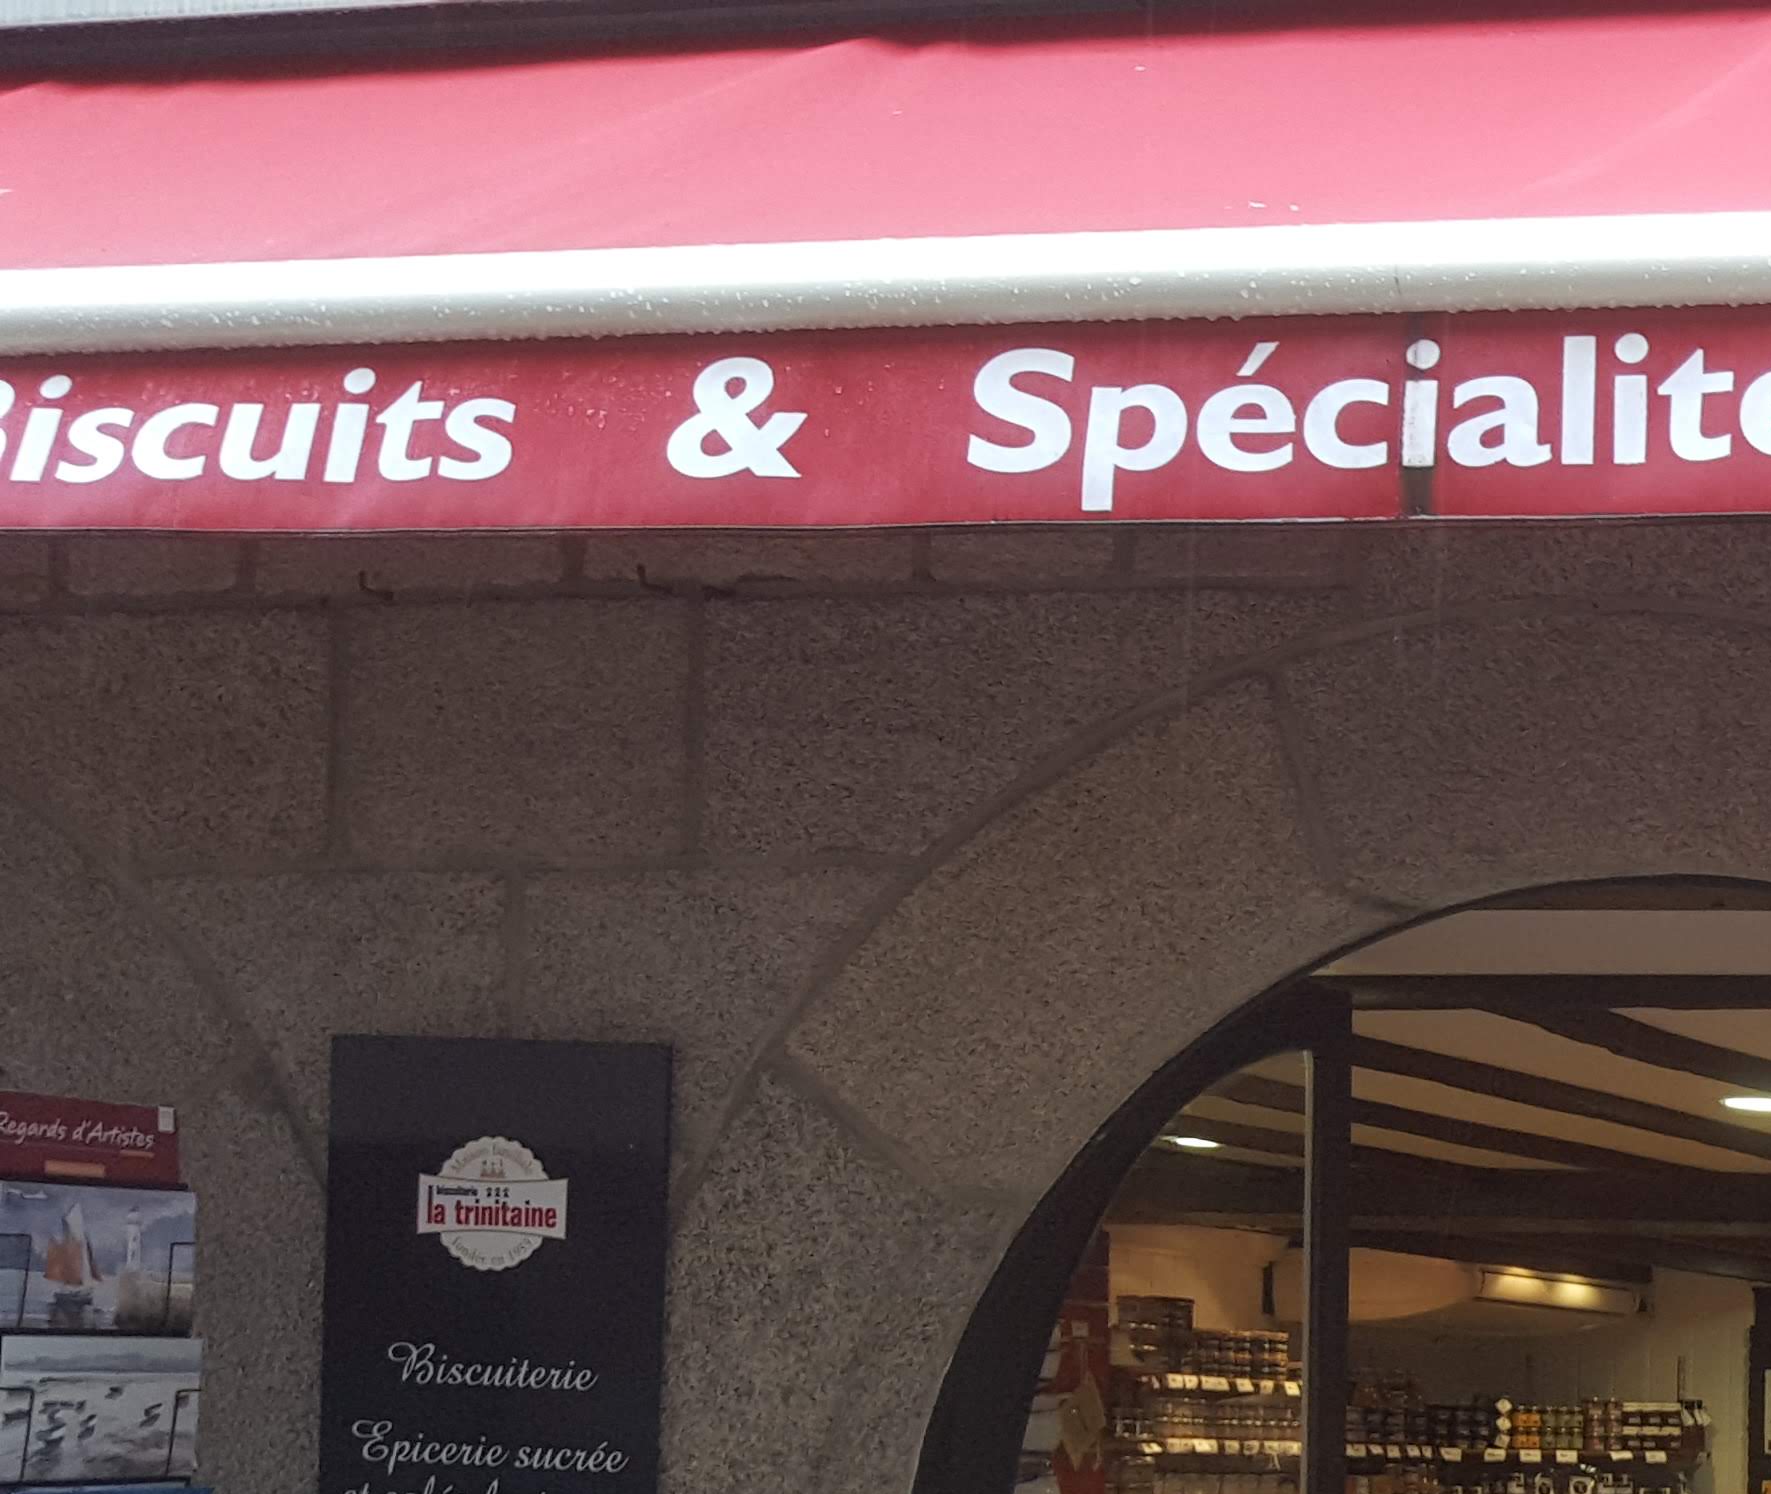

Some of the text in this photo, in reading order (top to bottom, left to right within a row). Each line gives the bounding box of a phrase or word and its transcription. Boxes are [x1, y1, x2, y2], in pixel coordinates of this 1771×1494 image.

[0, 366, 516, 488] iscuits
[666, 356, 803, 479] &
[72, 1119, 155, 1149] d'Artistes
[427, 1185, 557, 1228] la trinitaine
[388, 1341, 599, 1392] Biscuiterie
[351, 1419, 630, 1476] Epicerie sucrée
